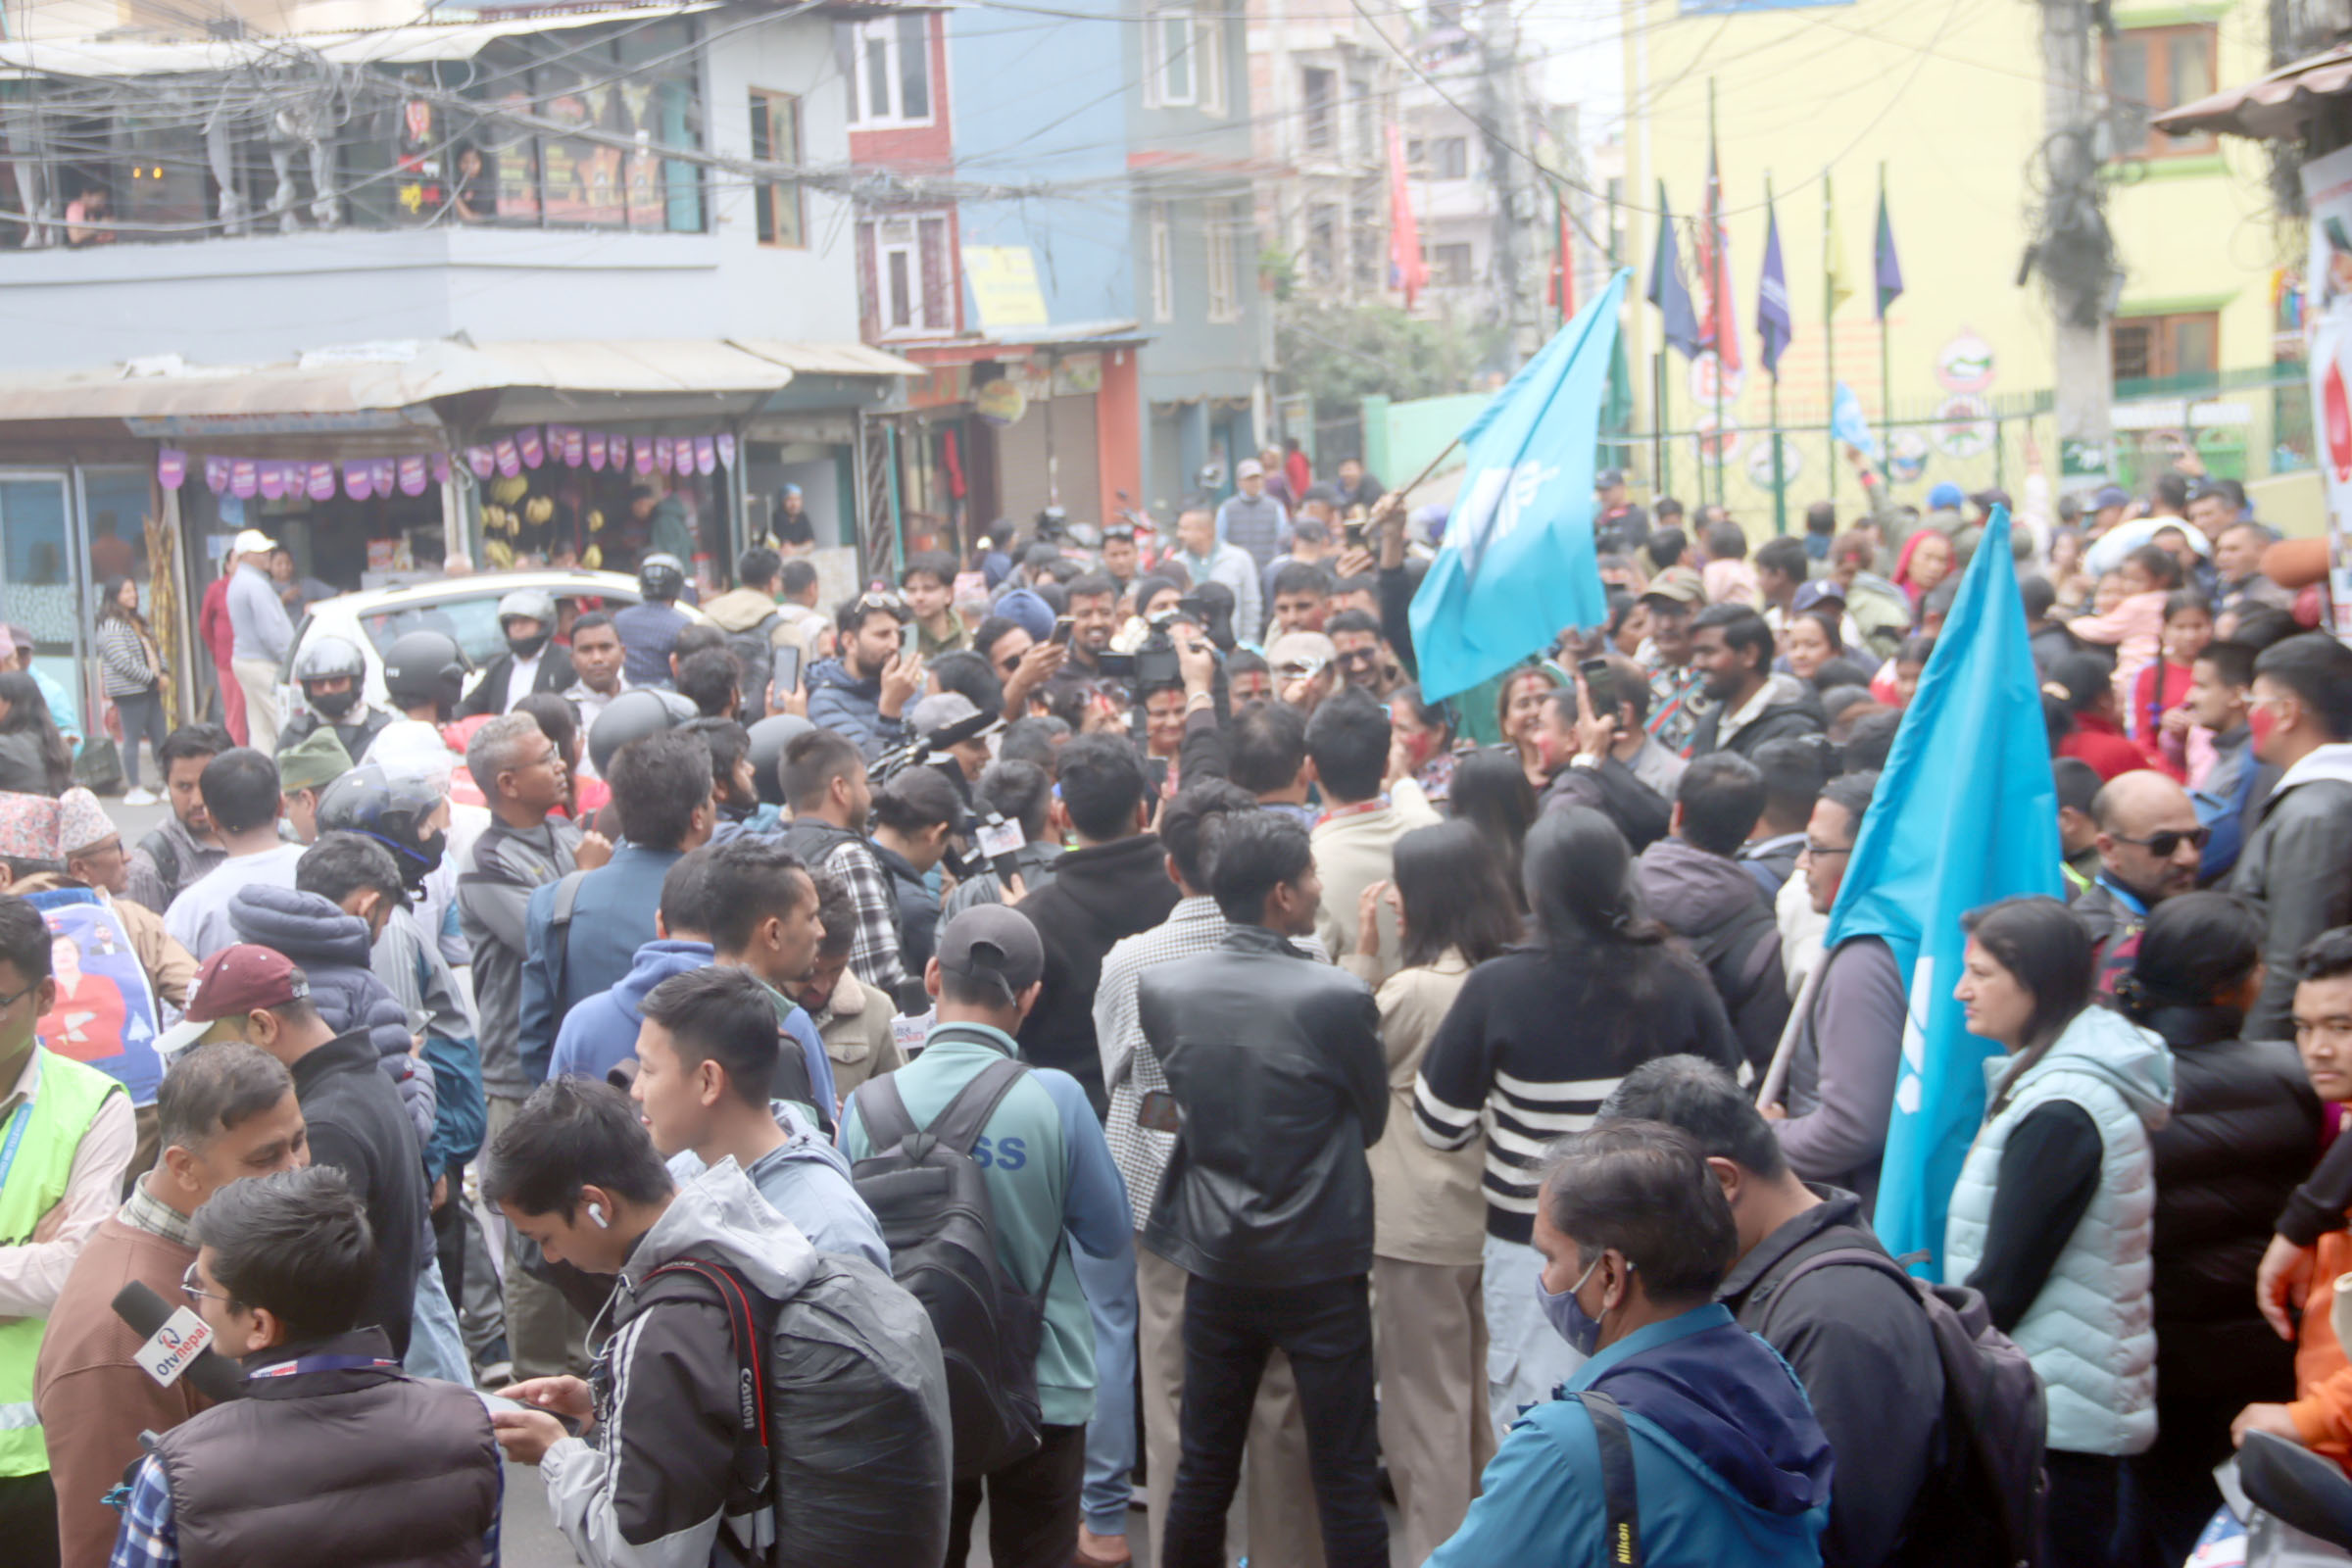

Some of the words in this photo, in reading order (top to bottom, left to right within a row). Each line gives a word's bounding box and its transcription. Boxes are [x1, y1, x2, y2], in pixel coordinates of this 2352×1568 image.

[157, 1321, 210, 1376] Otvnepal
[741, 1368, 755, 1429] Canon
[1618, 1523, 1631, 1565] Nikon
